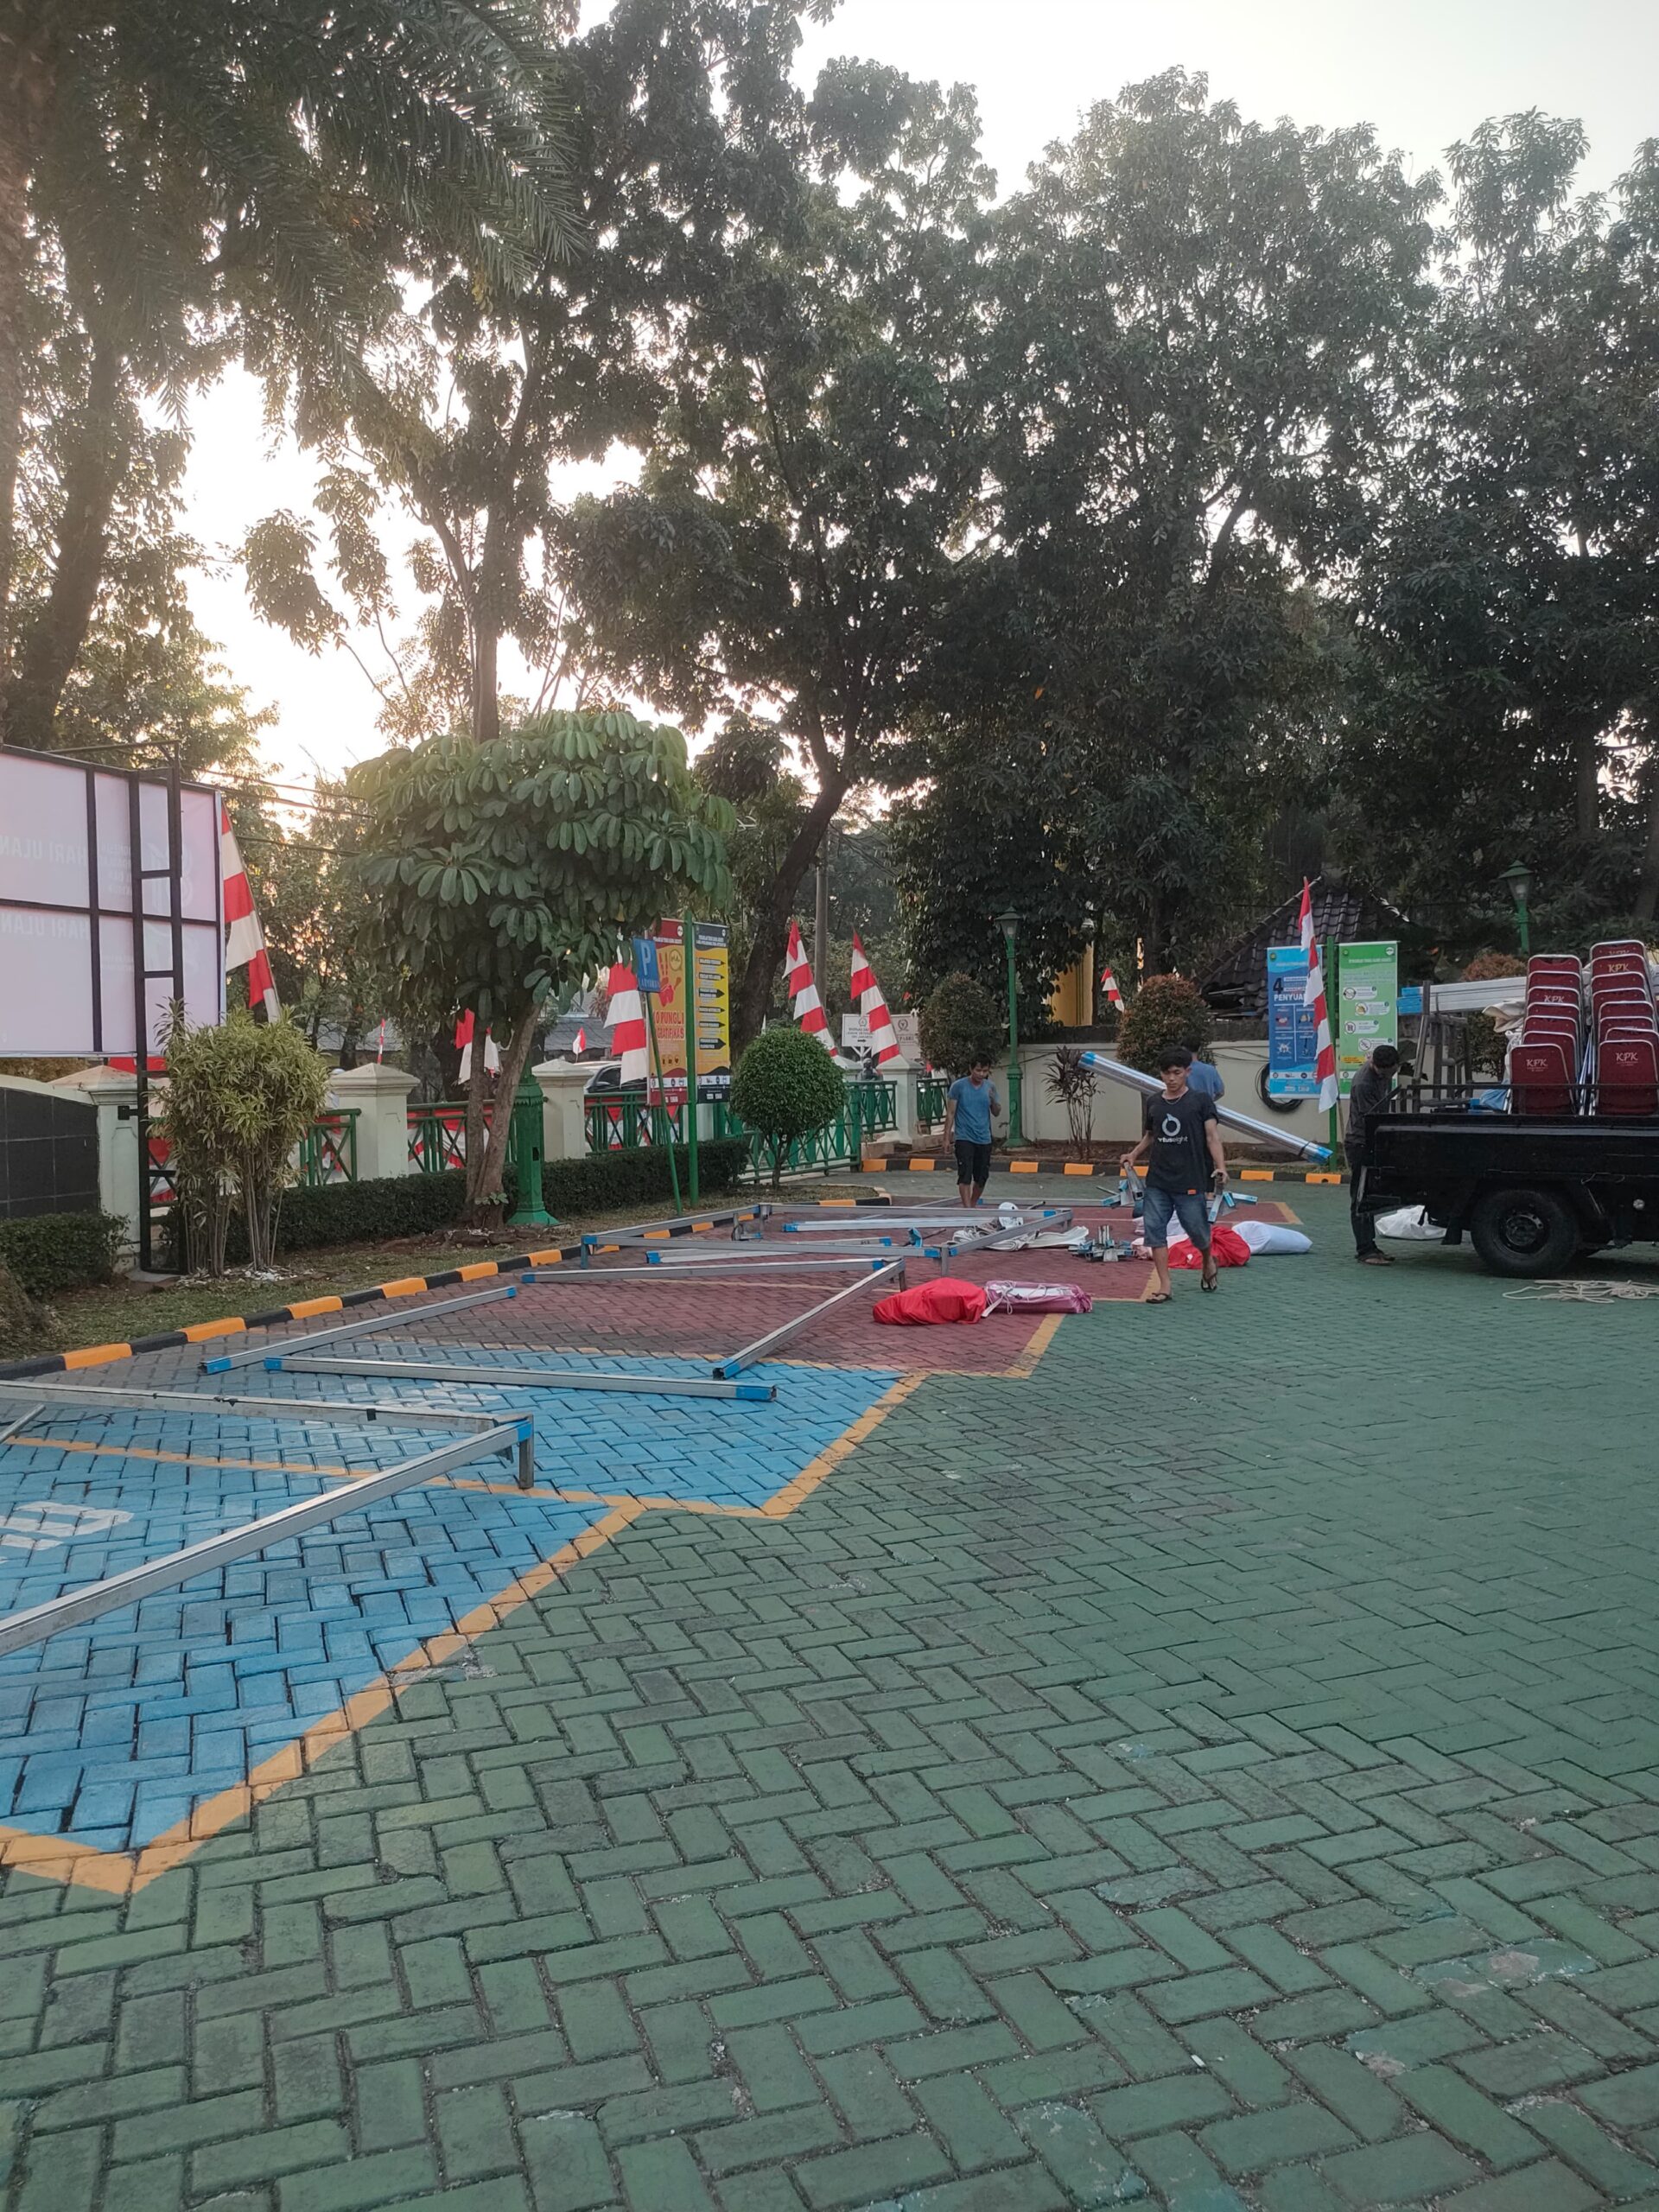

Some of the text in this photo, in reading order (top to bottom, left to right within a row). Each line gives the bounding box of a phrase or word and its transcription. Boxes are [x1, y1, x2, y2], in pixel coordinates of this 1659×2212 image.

[640, 943, 651, 976] P
[1608, 963, 1630, 973] KPK
[1273, 977, 1284, 995] 4
[1616, 1052, 1638, 1062] KPK
[1526, 1058, 1548, 1067] KPK
